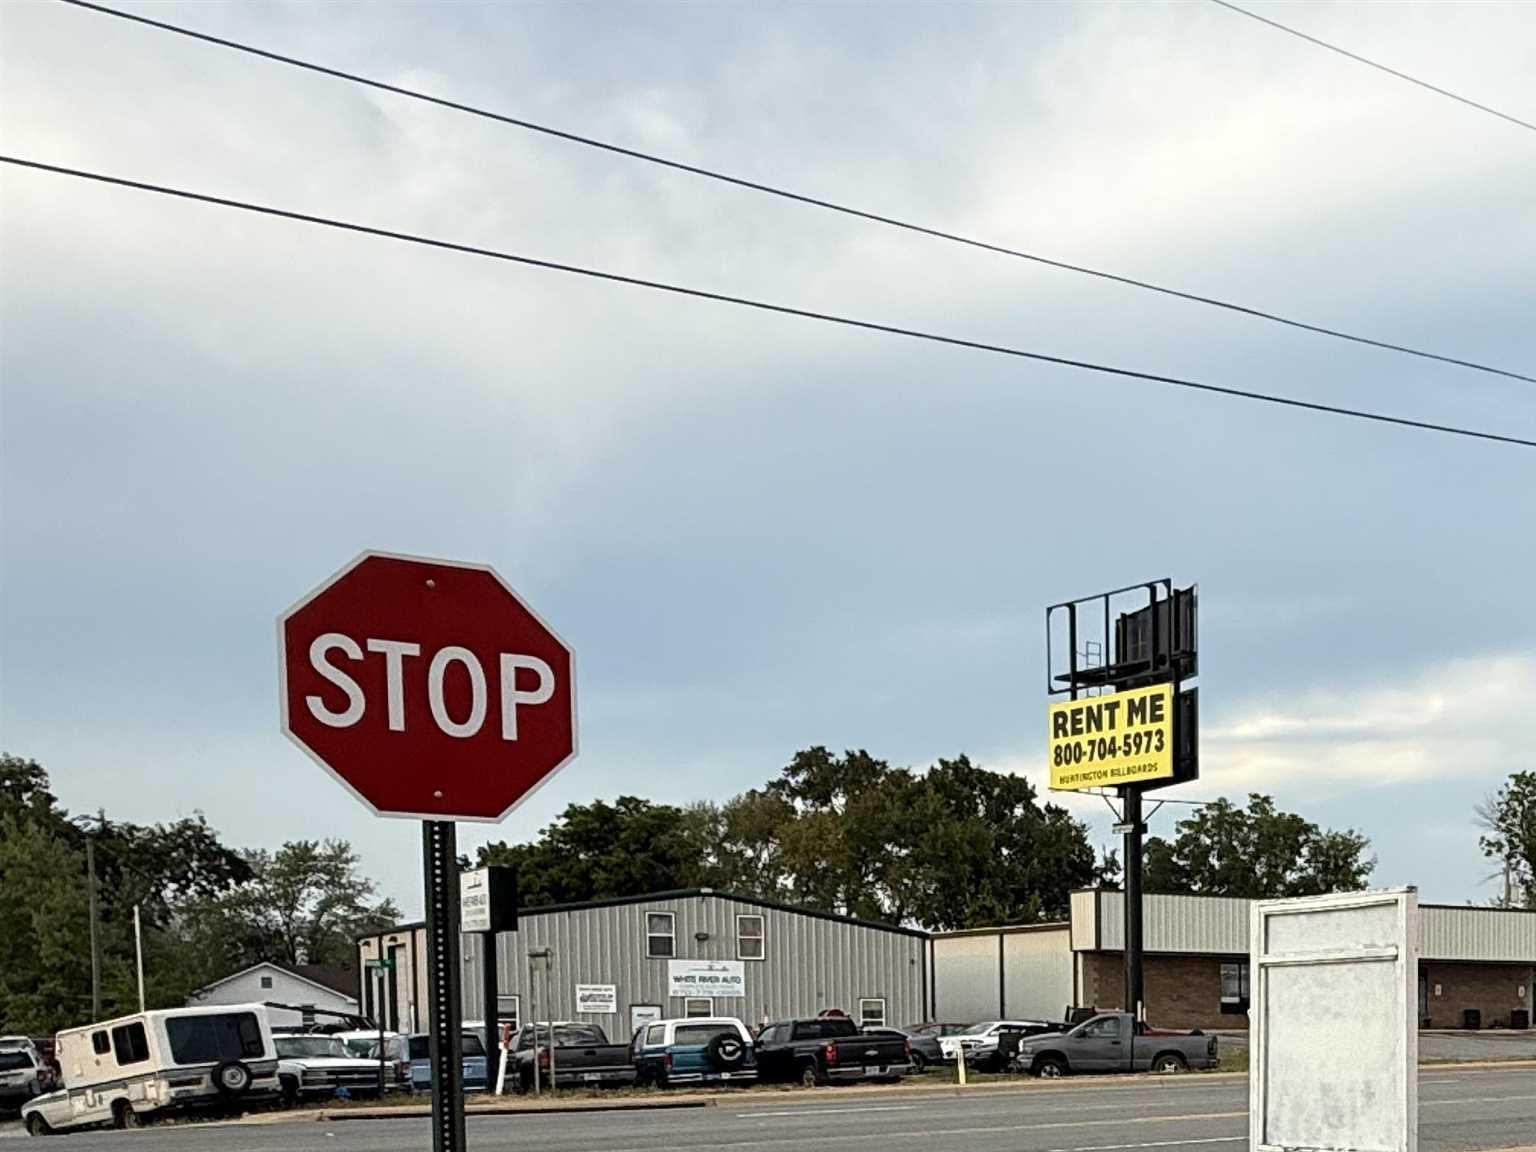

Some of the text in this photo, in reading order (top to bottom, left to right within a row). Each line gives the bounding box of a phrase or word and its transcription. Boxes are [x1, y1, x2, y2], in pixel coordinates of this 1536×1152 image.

[305, 632, 556, 742] STOP
[1053, 693, 1164, 739] RENT ME
[1054, 728, 1165, 768] 800-704-5973
[1059, 762, 1158, 785] HUNTINGTON BILLBOARDS
[673, 975, 742, 985] WHITE RIVER AUTO
